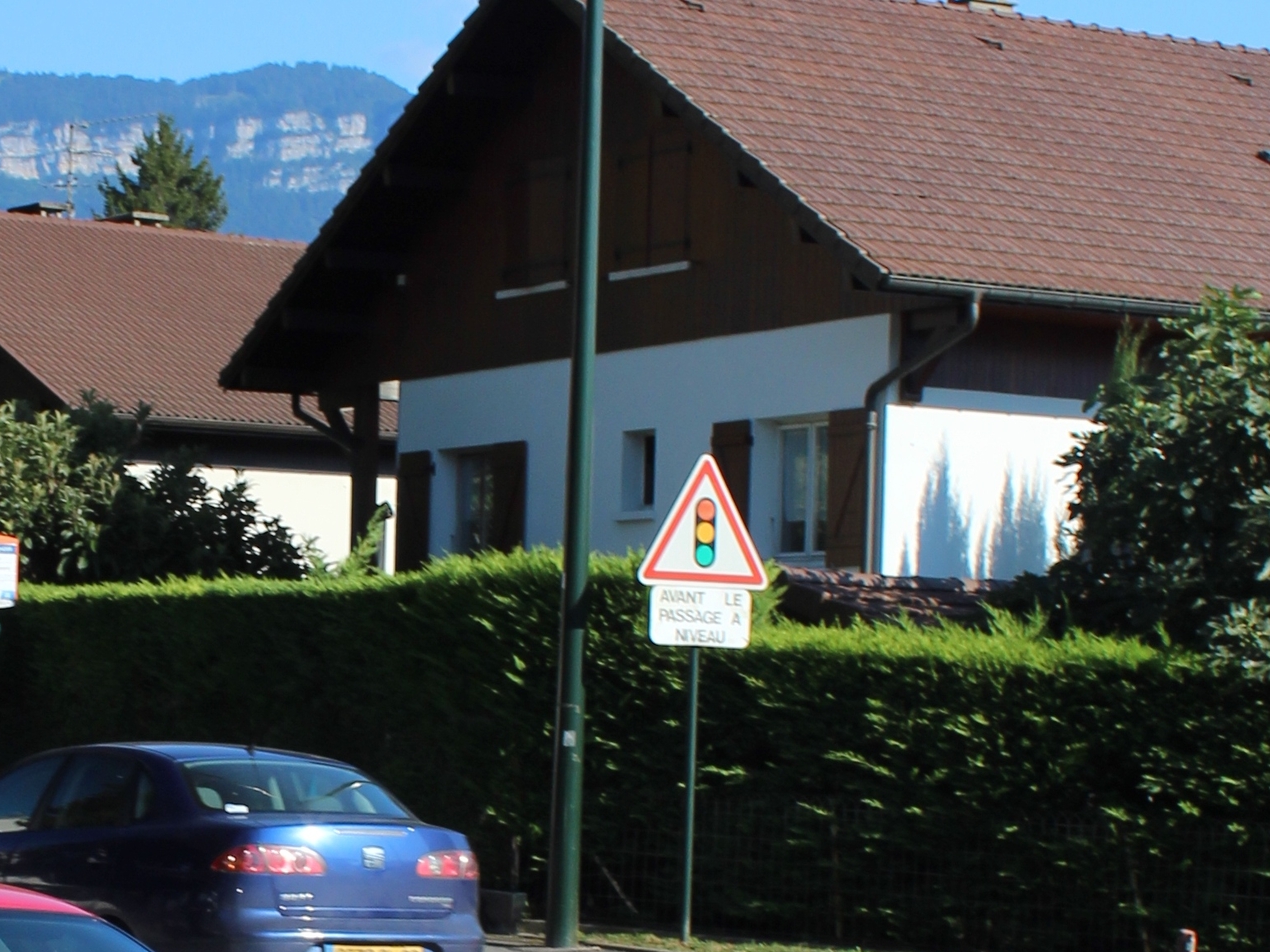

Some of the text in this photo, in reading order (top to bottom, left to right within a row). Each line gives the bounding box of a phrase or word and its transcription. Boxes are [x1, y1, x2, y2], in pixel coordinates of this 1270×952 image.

[659, 589, 743, 606] AVANT LE
[658, 608, 722, 624] PASSAGE
[675, 628, 726, 644] NIVEAU
